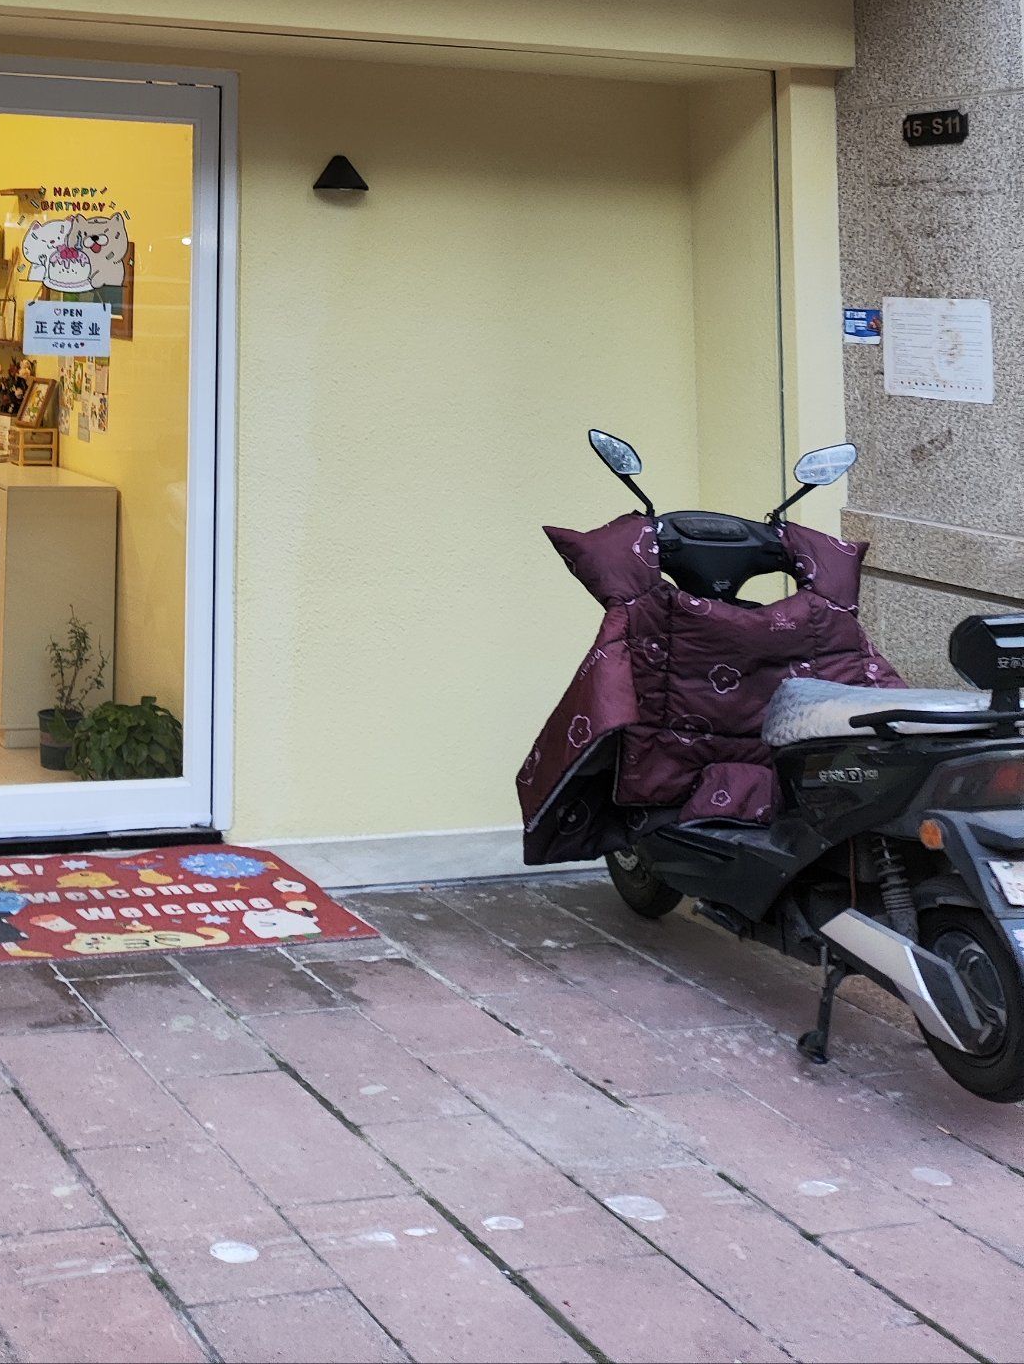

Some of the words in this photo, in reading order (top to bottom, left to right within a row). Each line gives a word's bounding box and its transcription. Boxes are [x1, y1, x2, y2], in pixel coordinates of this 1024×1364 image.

[53, 186, 98, 198] HAPPY
[40, 200, 106, 212] BIRTHDAY
[34, 320, 101, 337] 正在营业
